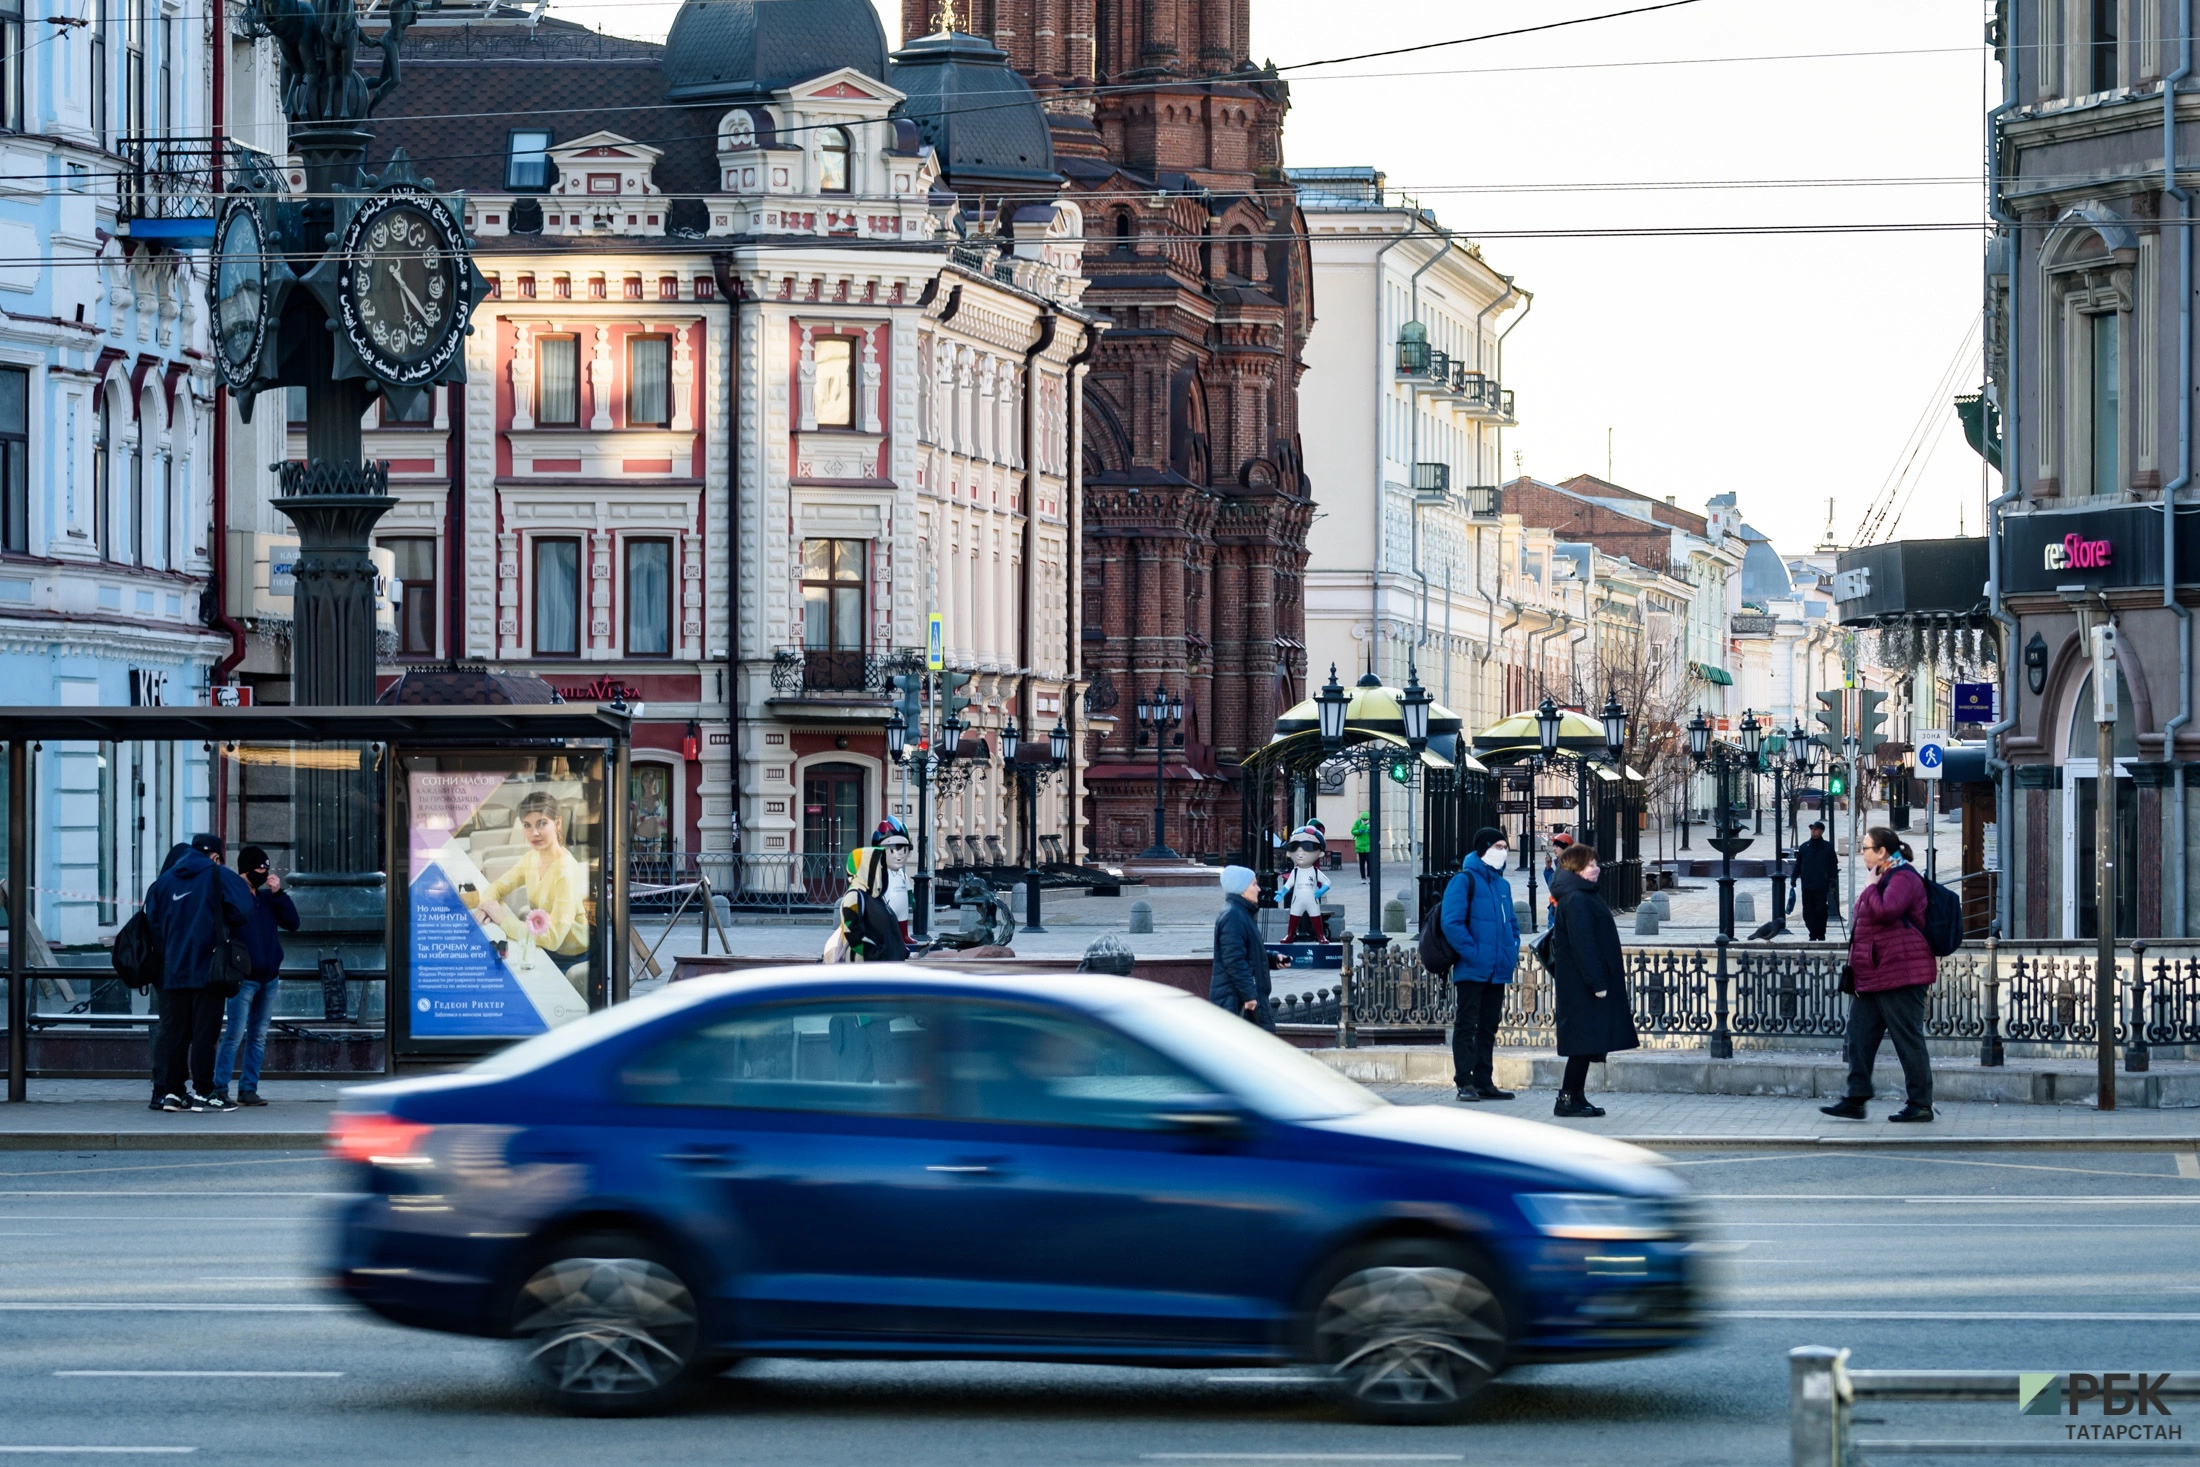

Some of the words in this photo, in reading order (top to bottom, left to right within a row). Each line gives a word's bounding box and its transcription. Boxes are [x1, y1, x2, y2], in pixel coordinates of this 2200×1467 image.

[2044, 533, 2111, 570] re:Store
[280, 552, 301, 560] КАФ
[272, 578, 295, 587] ПЕКА
[138, 669, 168, 706] KFC
[557, 678, 641, 700] MILAVISA
[422, 776, 458, 786] СОТНИ
[460, 776, 495, 785] ЧАСОВ
[430, 795, 480, 803] ПРОВОДИШЬ
[428, 913, 467, 921] МИНУТЫ
[417, 943, 430, 951] Так
[431, 943, 469, 951] ПОЧЕМУ
[429, 951, 469, 959] избегаешь
